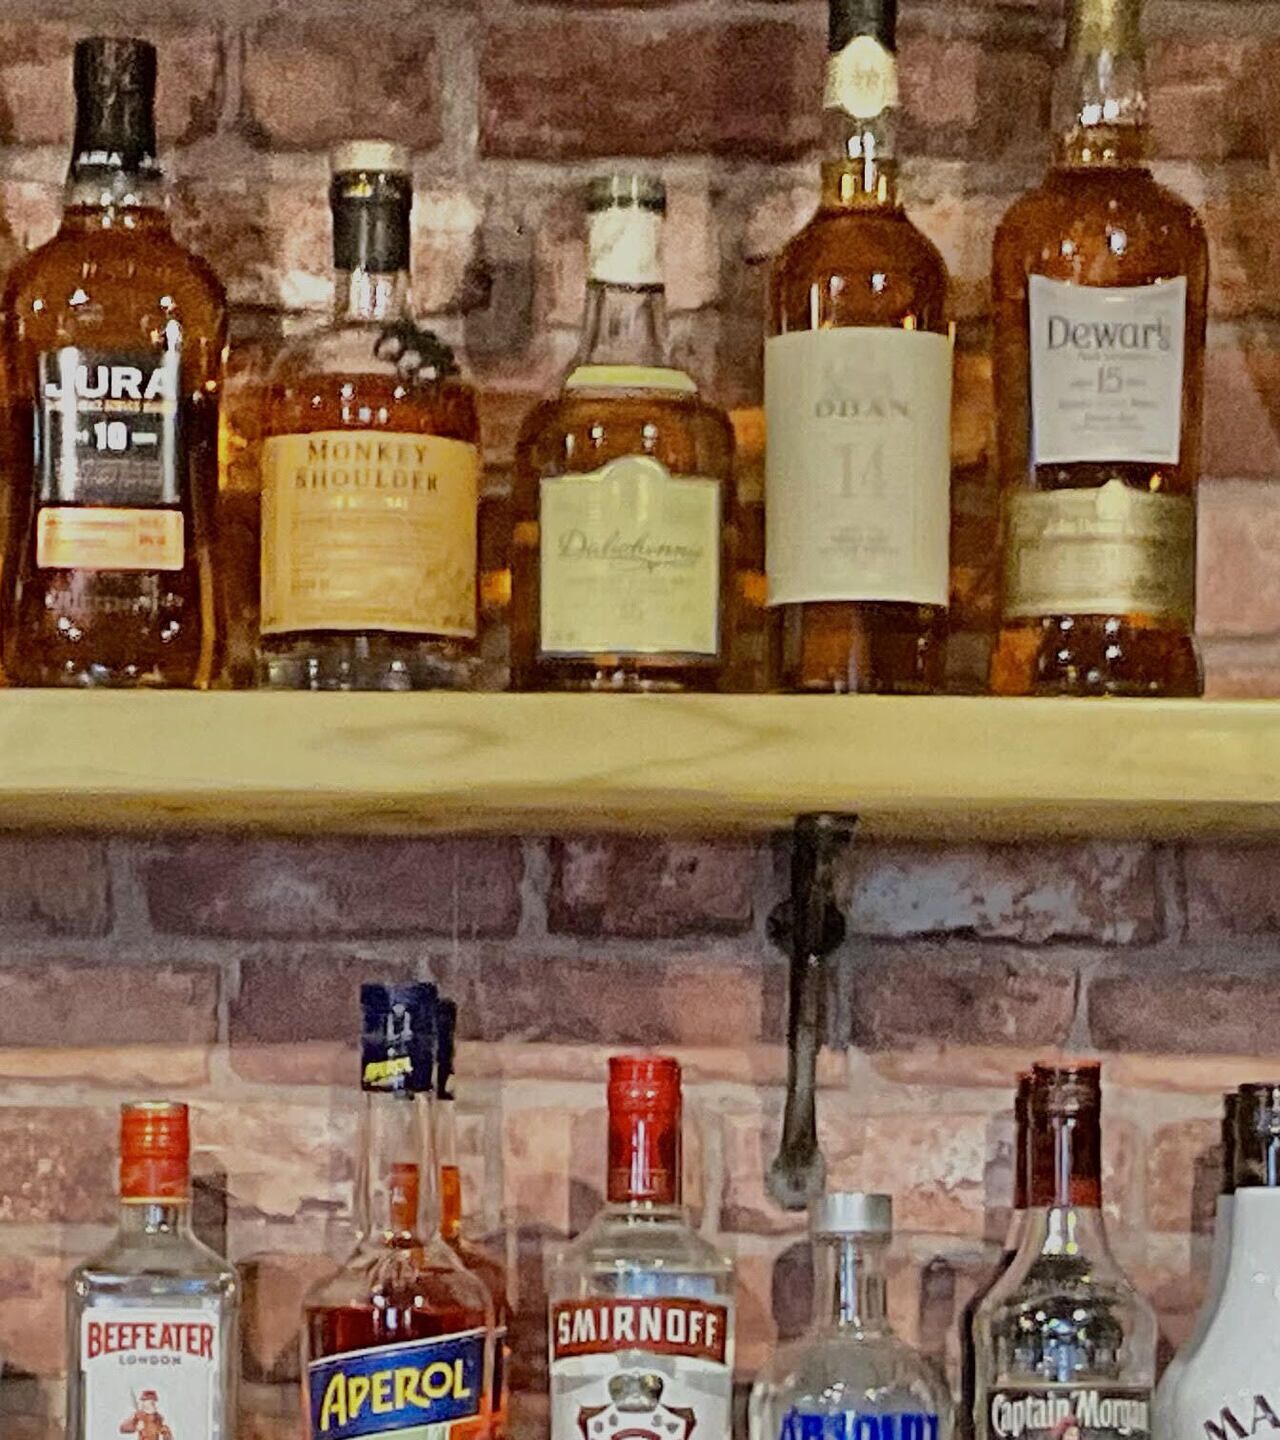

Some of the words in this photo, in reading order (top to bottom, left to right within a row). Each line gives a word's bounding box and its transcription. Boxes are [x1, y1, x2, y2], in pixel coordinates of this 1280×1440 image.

[44, 364, 177, 400] JURA
[93, 420, 128, 451] 10
[306, 440, 431, 466] MONKEY
[295, 467, 439, 493] SHOULDER
[87, 1321, 215, 1361] BEEFEATER
[556, 1304, 719, 1350] SMIRNOFF
[118, 1355, 183, 1366] LONDON
[320, 1357, 472, 1432] APEROL
[991, 1392, 1070, 1437] Captain
[1073, 1389, 1149, 1435] Morgan
